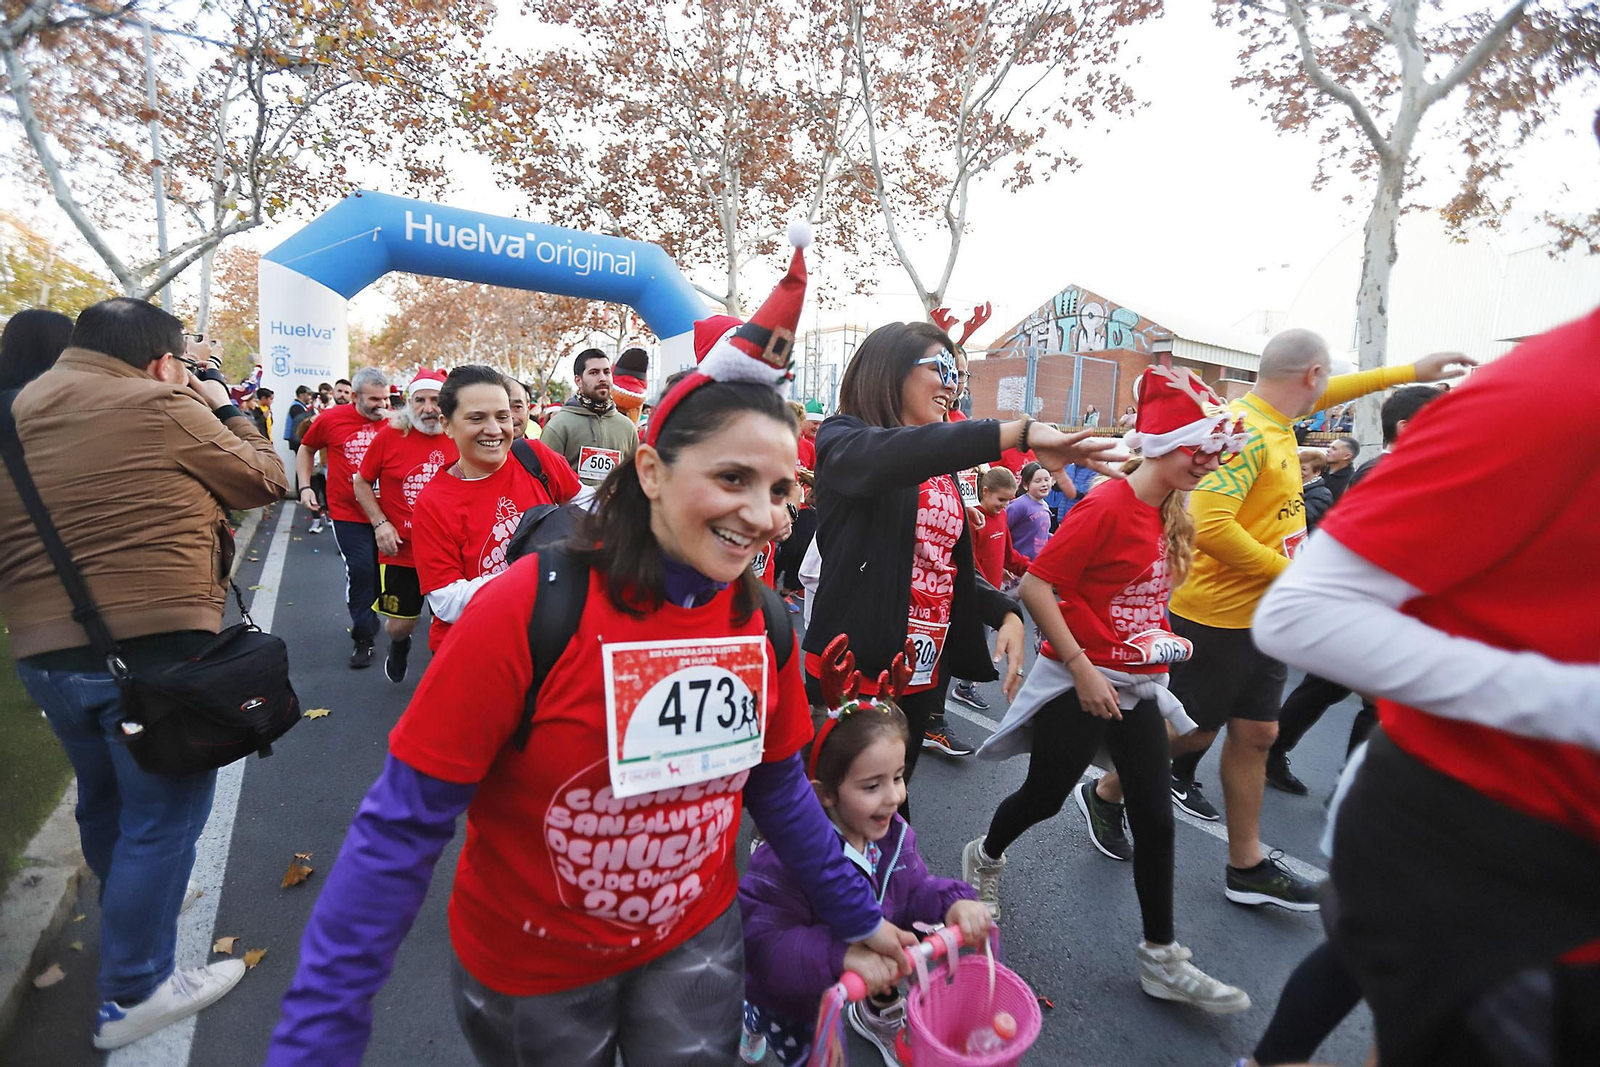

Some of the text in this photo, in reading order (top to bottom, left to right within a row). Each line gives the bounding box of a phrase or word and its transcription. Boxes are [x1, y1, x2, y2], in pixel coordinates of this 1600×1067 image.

[405, 210, 636, 277] Huelva original
[271, 321, 332, 340] Huelva
[294, 366, 331, 377] HUELVA
[590, 456, 610, 470] 505
[663, 648, 697, 657] CARRERA
[692, 657, 717, 665] HUELVA
[659, 676, 737, 736] 473
[547, 806, 626, 837] SAN
[548, 803, 735, 871] DE HUELVA
[557, 856, 604, 891] 30
[604, 872, 635, 892] DE
[584, 873, 702, 925] 2023
